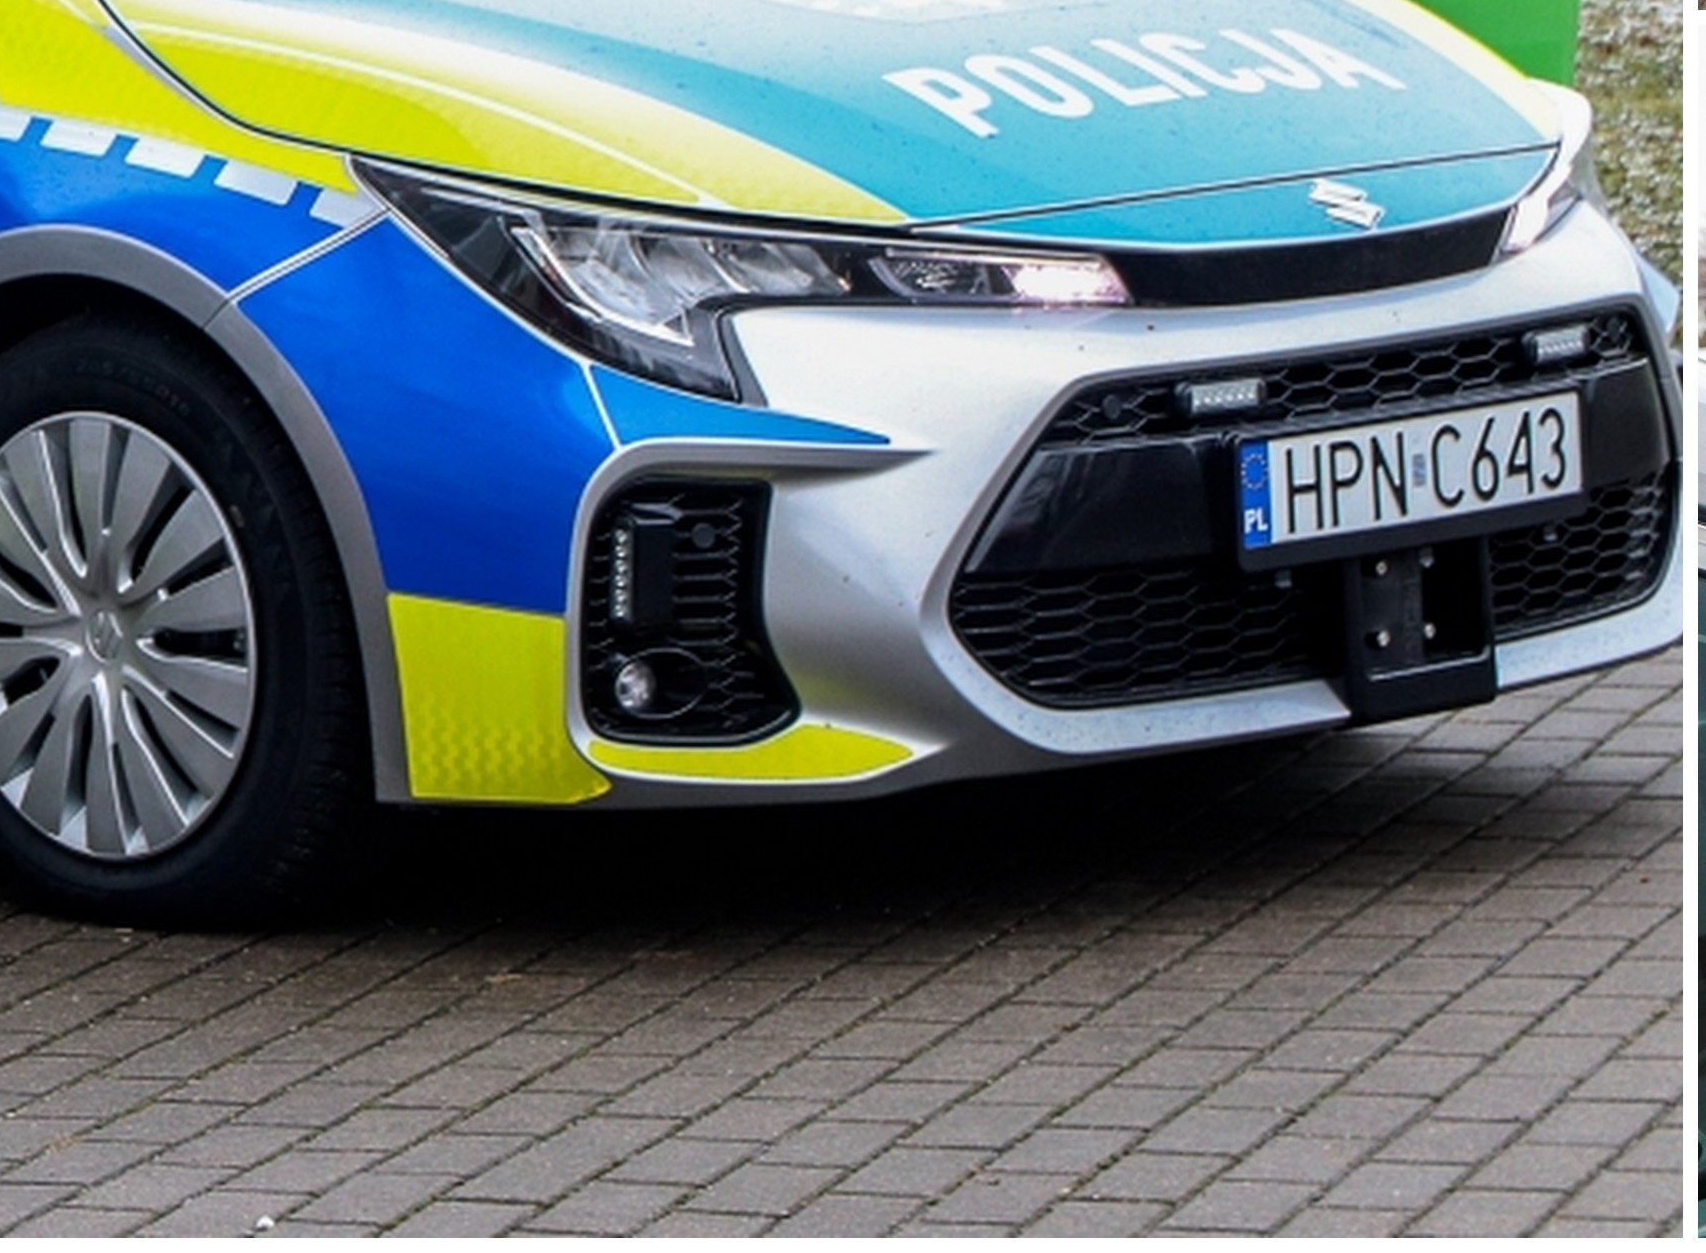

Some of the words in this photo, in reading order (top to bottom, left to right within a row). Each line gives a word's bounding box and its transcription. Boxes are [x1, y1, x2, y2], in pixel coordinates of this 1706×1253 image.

[882, 28, 1407, 139] POLICJA
[1244, 508, 1269, 534] PL
[1285, 431, 1408, 534] HPN
[1430, 408, 1566, 509] C643
